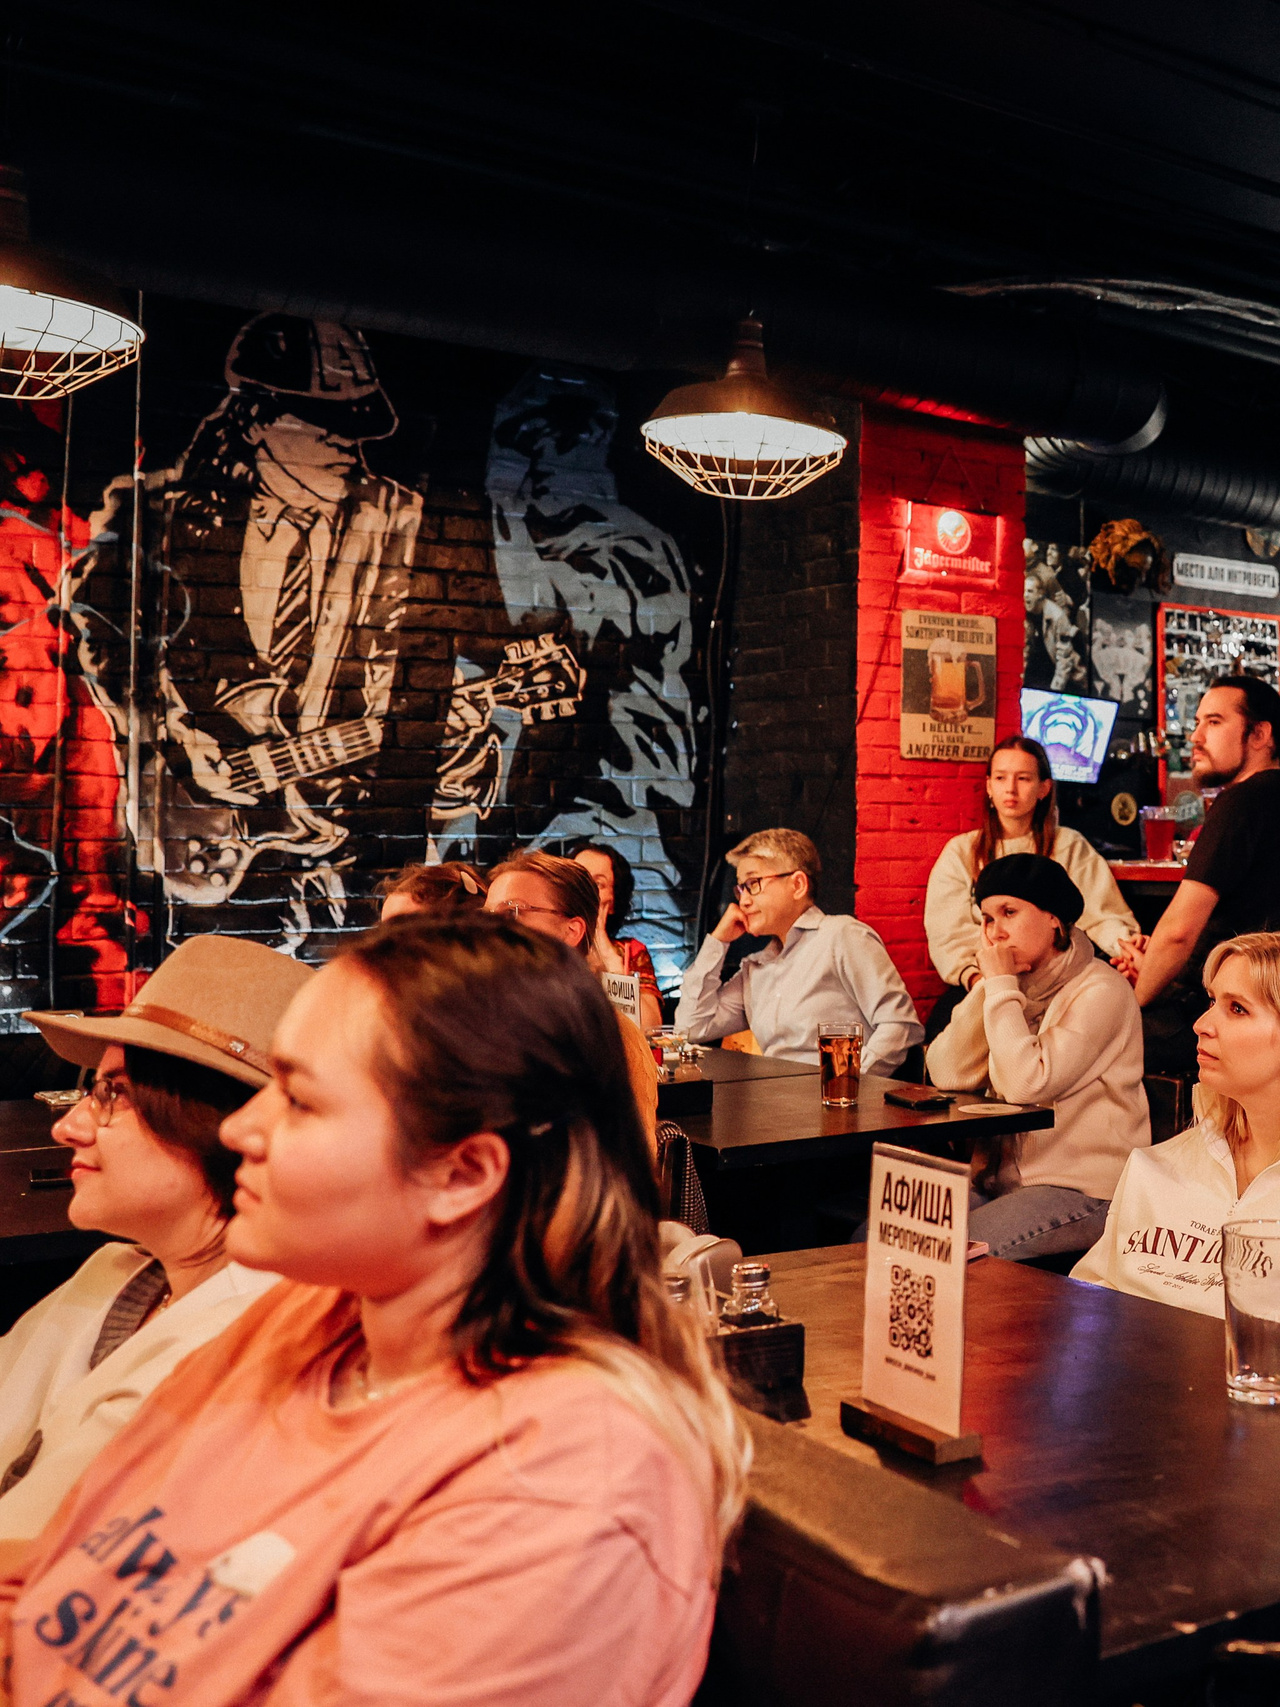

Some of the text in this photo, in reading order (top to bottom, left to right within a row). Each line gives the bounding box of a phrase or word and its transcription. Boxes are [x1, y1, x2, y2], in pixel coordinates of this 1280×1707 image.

[914, 547, 991, 573] Jägermeister
[1176, 562, 1205, 579] МЕСТО
[922, 723, 926, 733] I
[906, 743, 991, 758] ANOTHER BEER
[607, 978, 636, 1002] АФИША
[880, 1171, 953, 1230] АФИША
[1190, 1220, 1217, 1236] TORAE
[879, 1220, 953, 1265] МЕРОПРИЯТИЙ
[1122, 1226, 1205, 1264] SAINT
